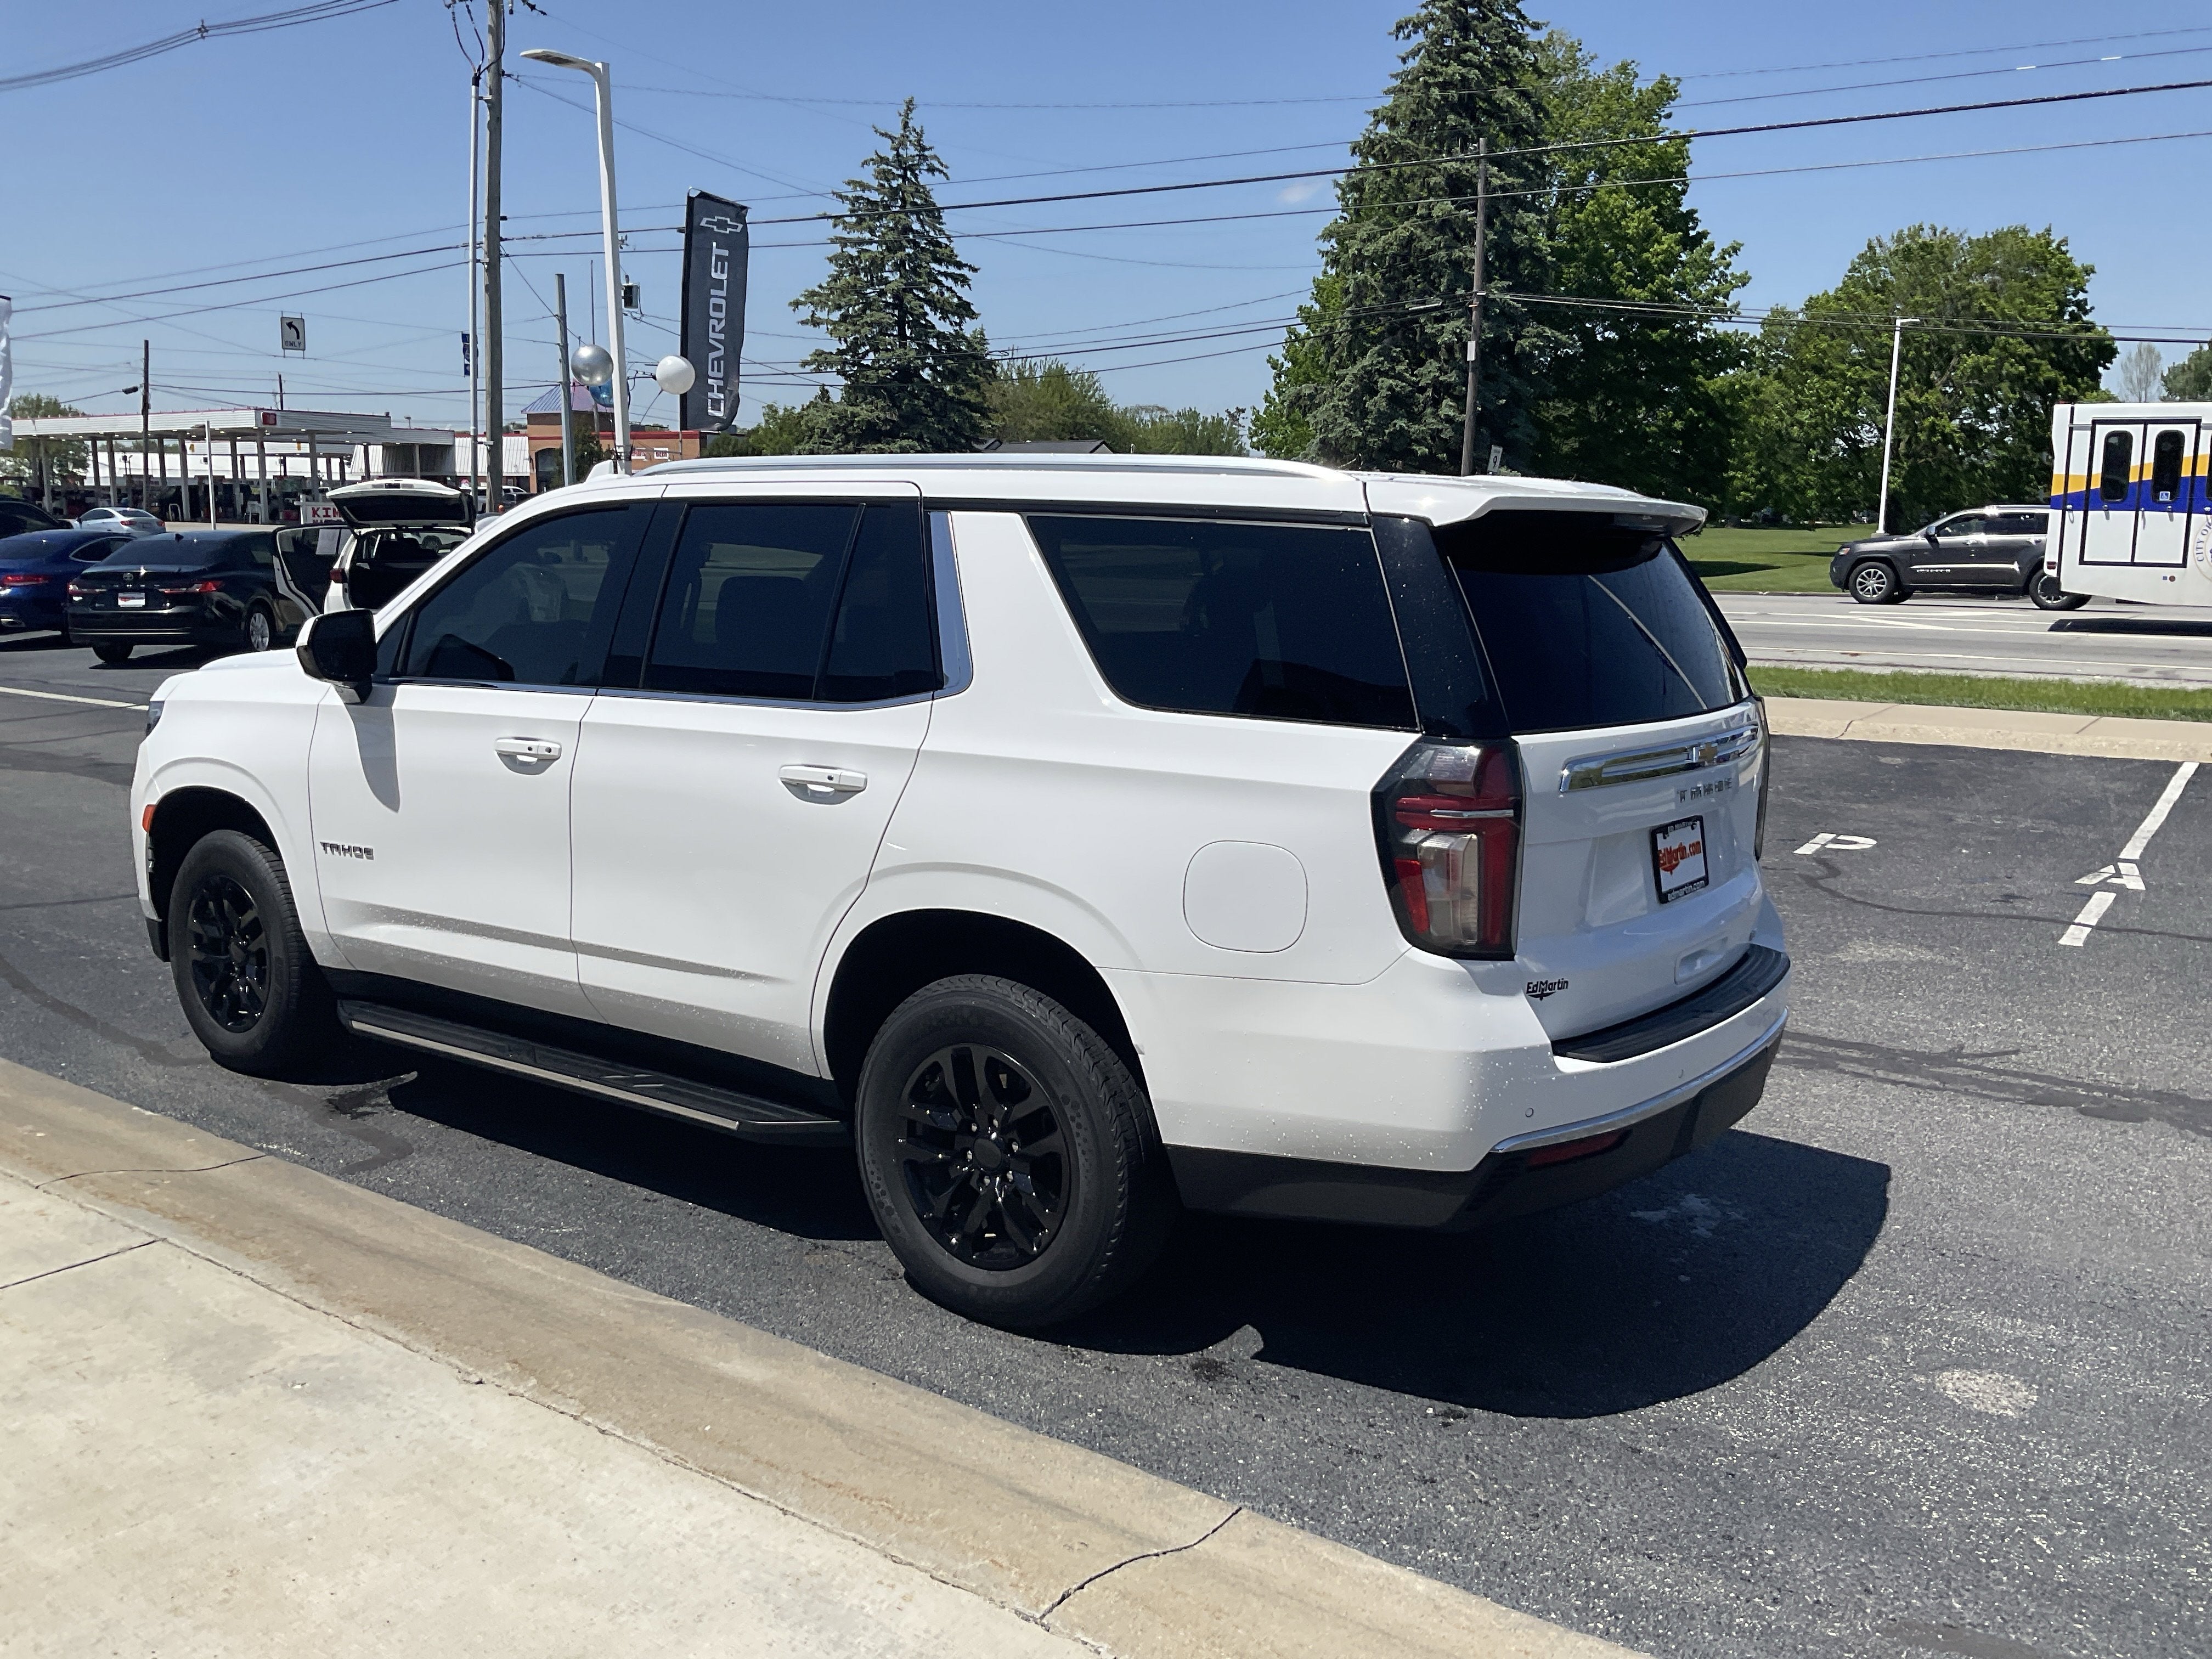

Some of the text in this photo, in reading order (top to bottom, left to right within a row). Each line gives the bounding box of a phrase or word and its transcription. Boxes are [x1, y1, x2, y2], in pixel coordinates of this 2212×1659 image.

[708, 241, 729, 417] CHEVROLET
[2196, 539, 2204, 562] CITY
[320, 842, 374, 861] TAHOE
[1793, 832, 1878, 855] P
[1668, 879, 1705, 901] edmartin.com
